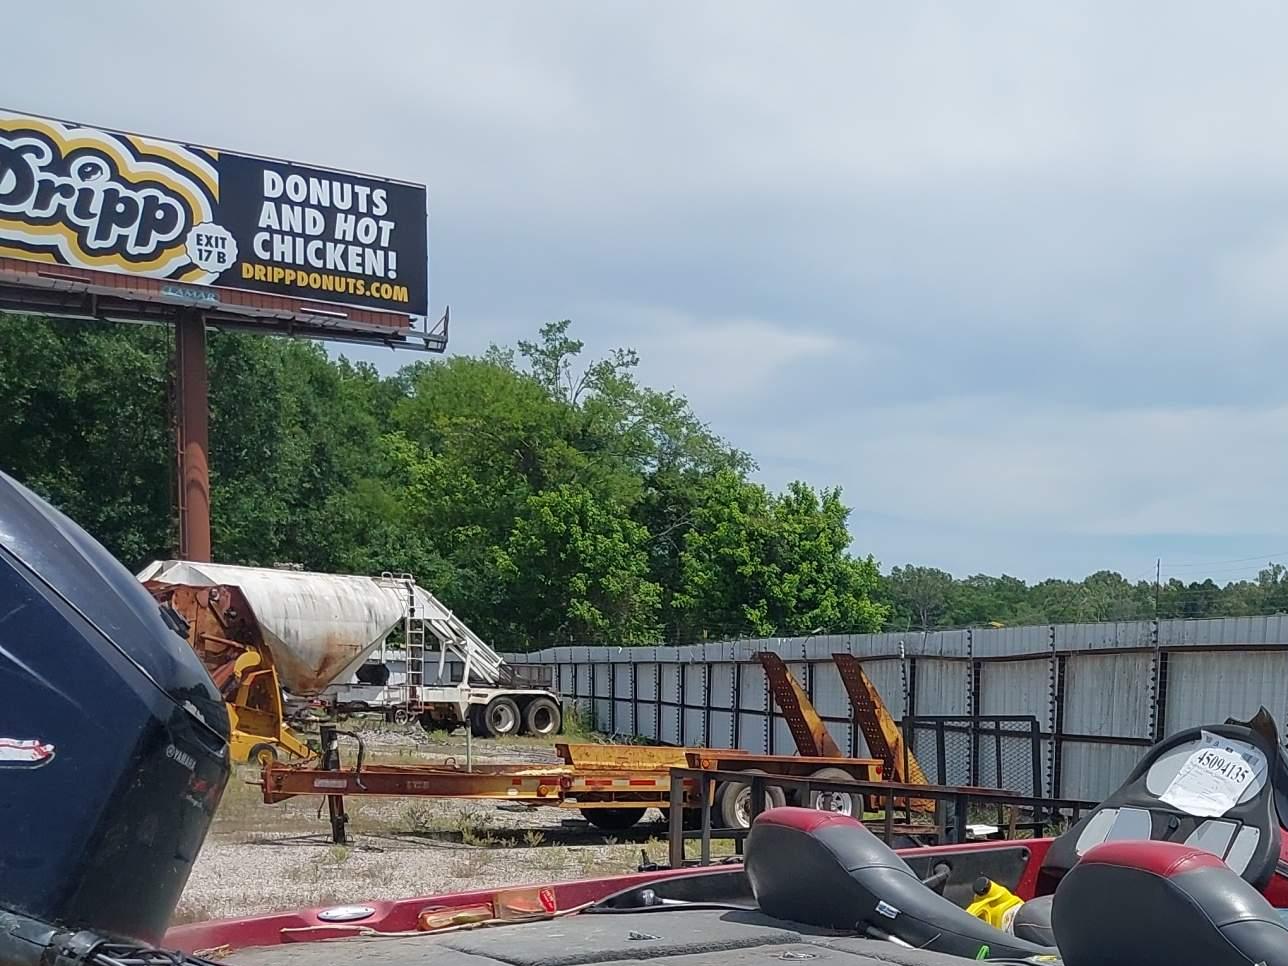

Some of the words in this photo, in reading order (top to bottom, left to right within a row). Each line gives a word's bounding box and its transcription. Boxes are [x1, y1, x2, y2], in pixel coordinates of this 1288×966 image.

[263, 169, 388, 216] DONUTS
[196, 233, 227, 249] EXIT
[258, 201, 326, 236] AND
[334, 212, 395, 247] HOT
[198, 248, 213, 262] 17
[217, 251, 227, 264] B
[253, 231, 397, 280] CHICKEN!
[242, 262, 409, 302] DRIPPDONUTS.COM
[174, 750, 197, 770] YAMAHA
[1198, 750, 1249, 783] 45094135
